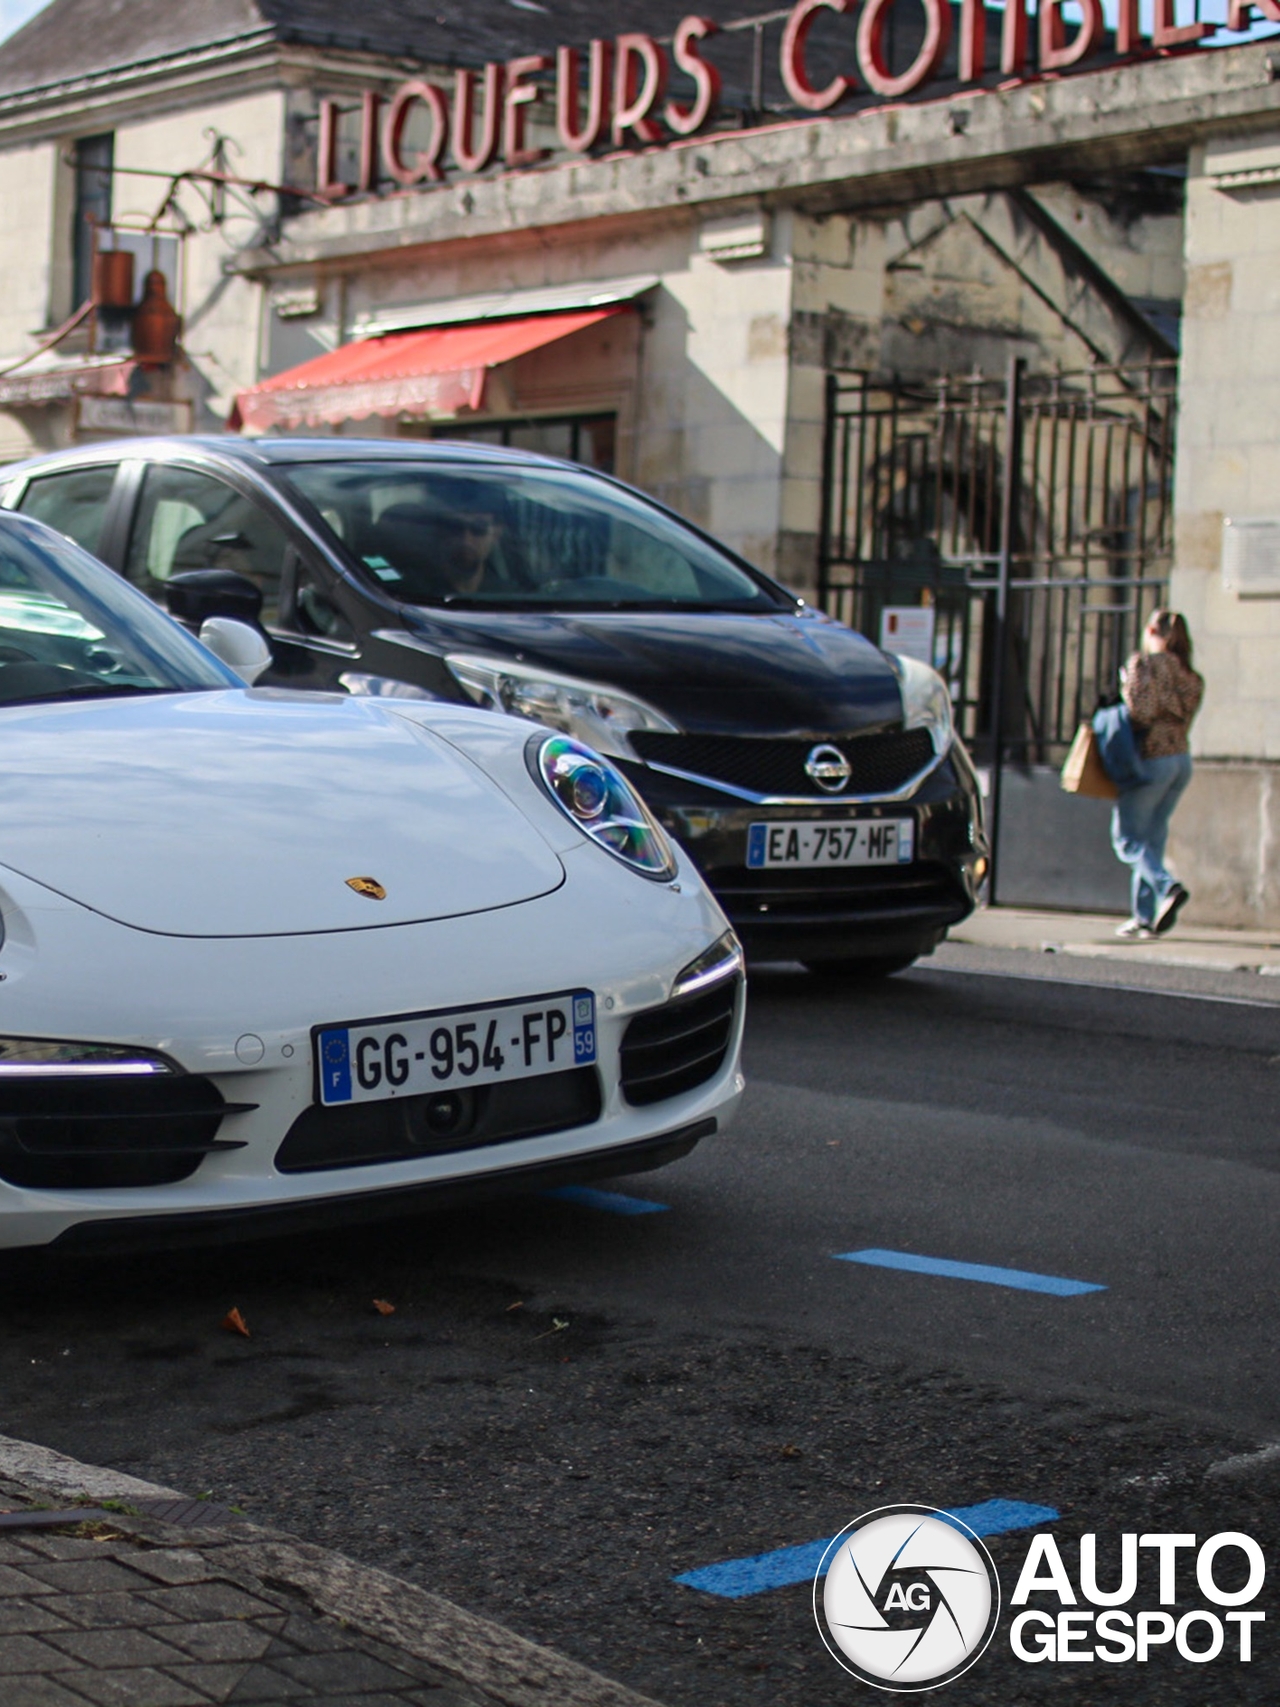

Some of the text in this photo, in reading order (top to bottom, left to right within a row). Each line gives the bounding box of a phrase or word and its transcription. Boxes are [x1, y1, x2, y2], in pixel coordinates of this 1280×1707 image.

[317, 16, 720, 197] LIQUEURS
[769, 826, 896, 861] EA-757-MF
[355, 1009, 566, 1090] GG-954-FP
[574, 1031, 594, 1055] 59
[332, 1071, 341, 1087] F
